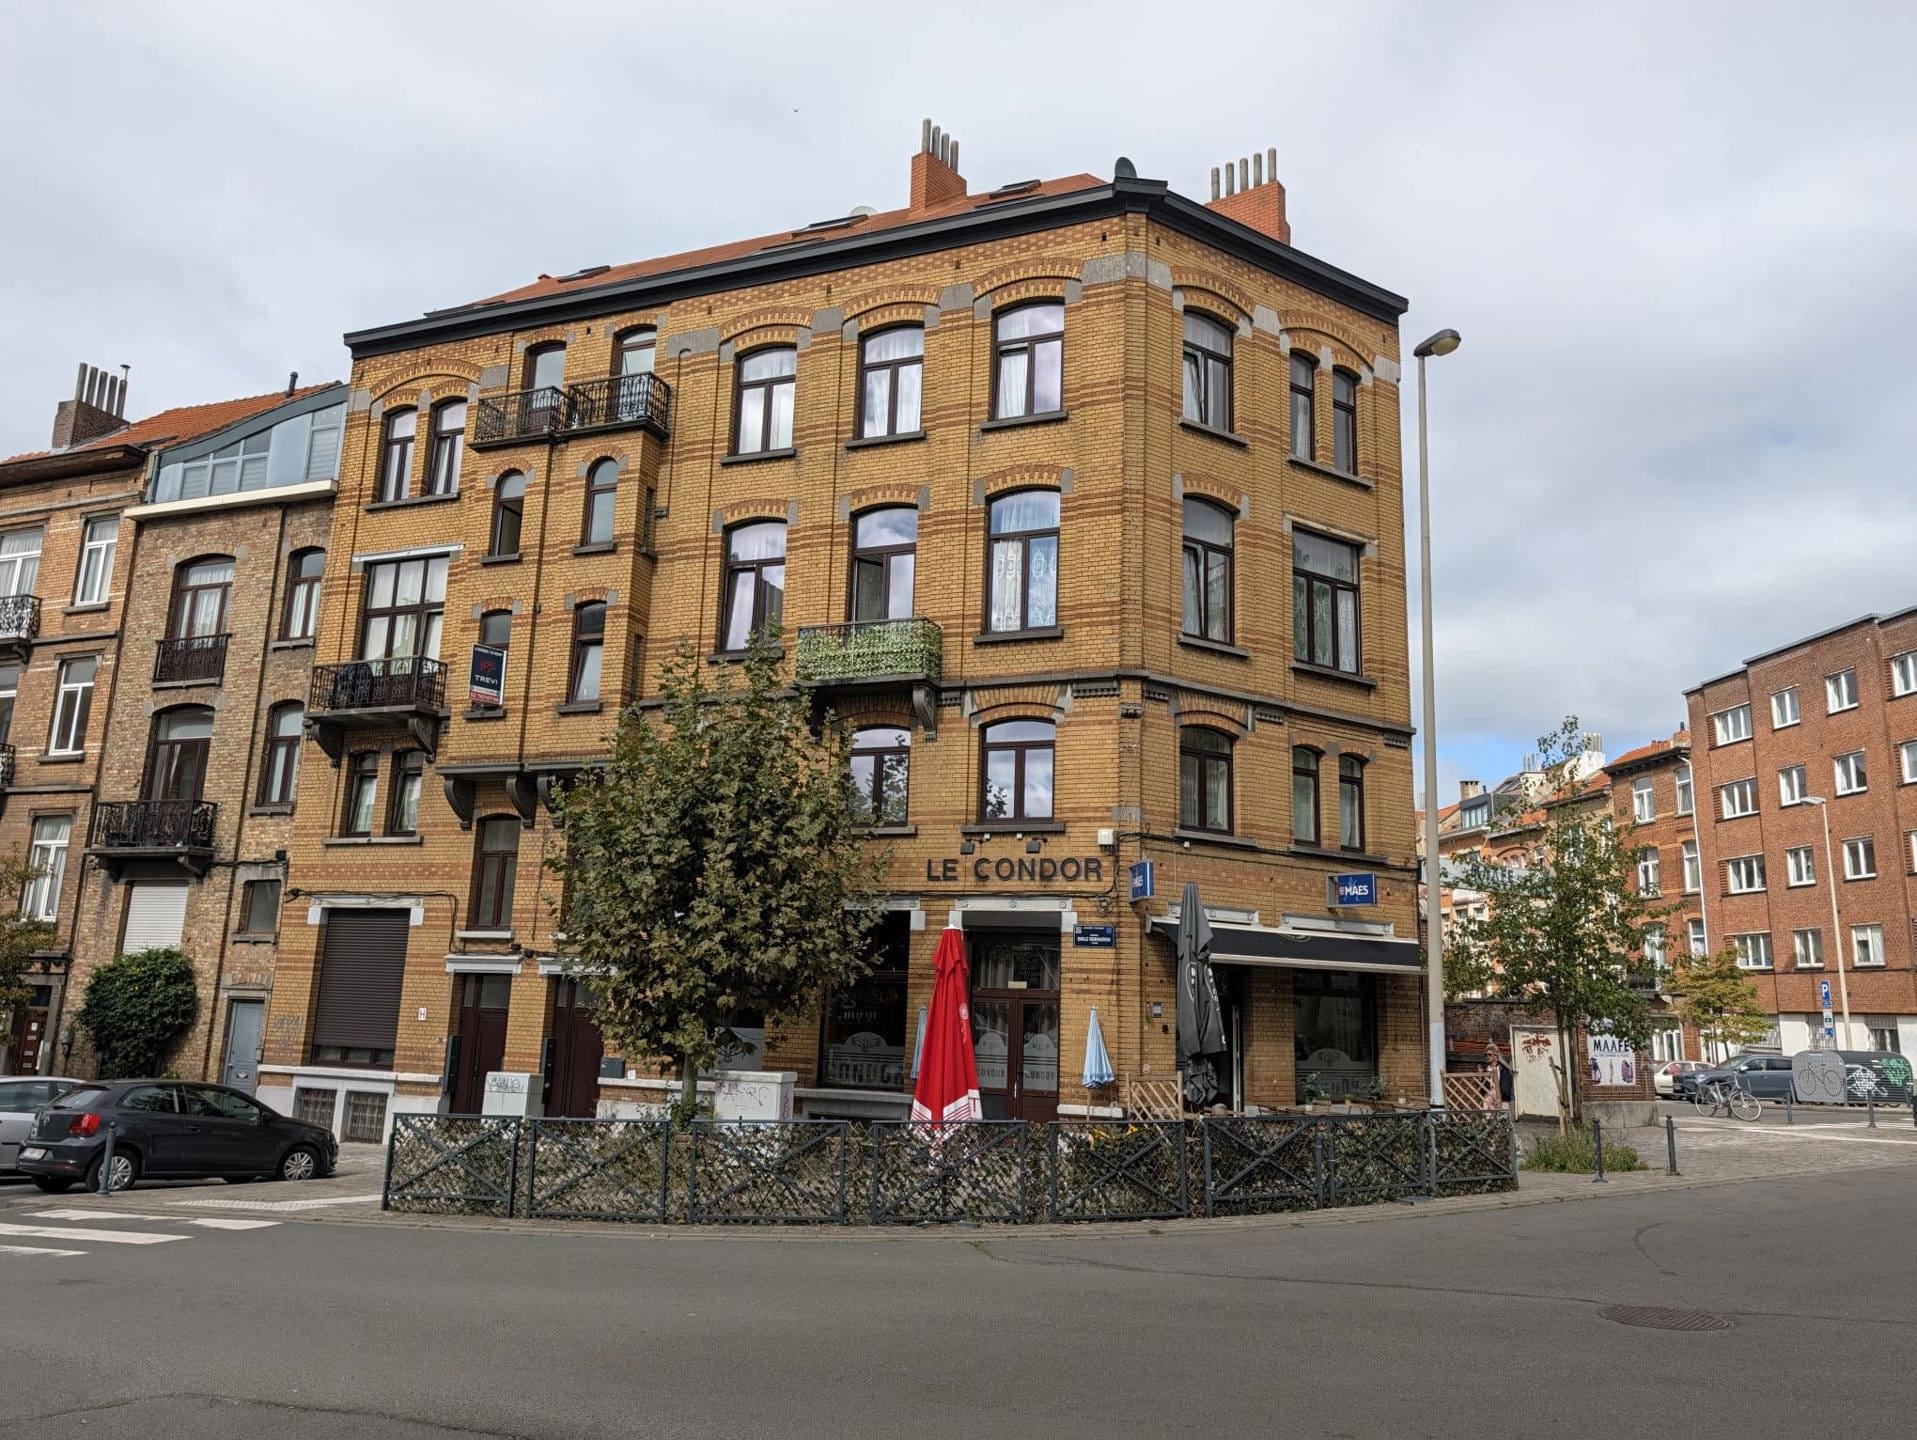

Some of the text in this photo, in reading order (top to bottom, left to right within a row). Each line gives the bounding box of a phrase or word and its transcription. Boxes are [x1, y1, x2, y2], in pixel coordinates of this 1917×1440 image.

[474, 674, 498, 685] TREVI
[927, 857, 1102, 881] LE CONDOR
[1345, 884, 1369, 896] MAES
[1821, 983, 1829, 998] P
[1593, 1039, 1630, 1052] MAAFE
